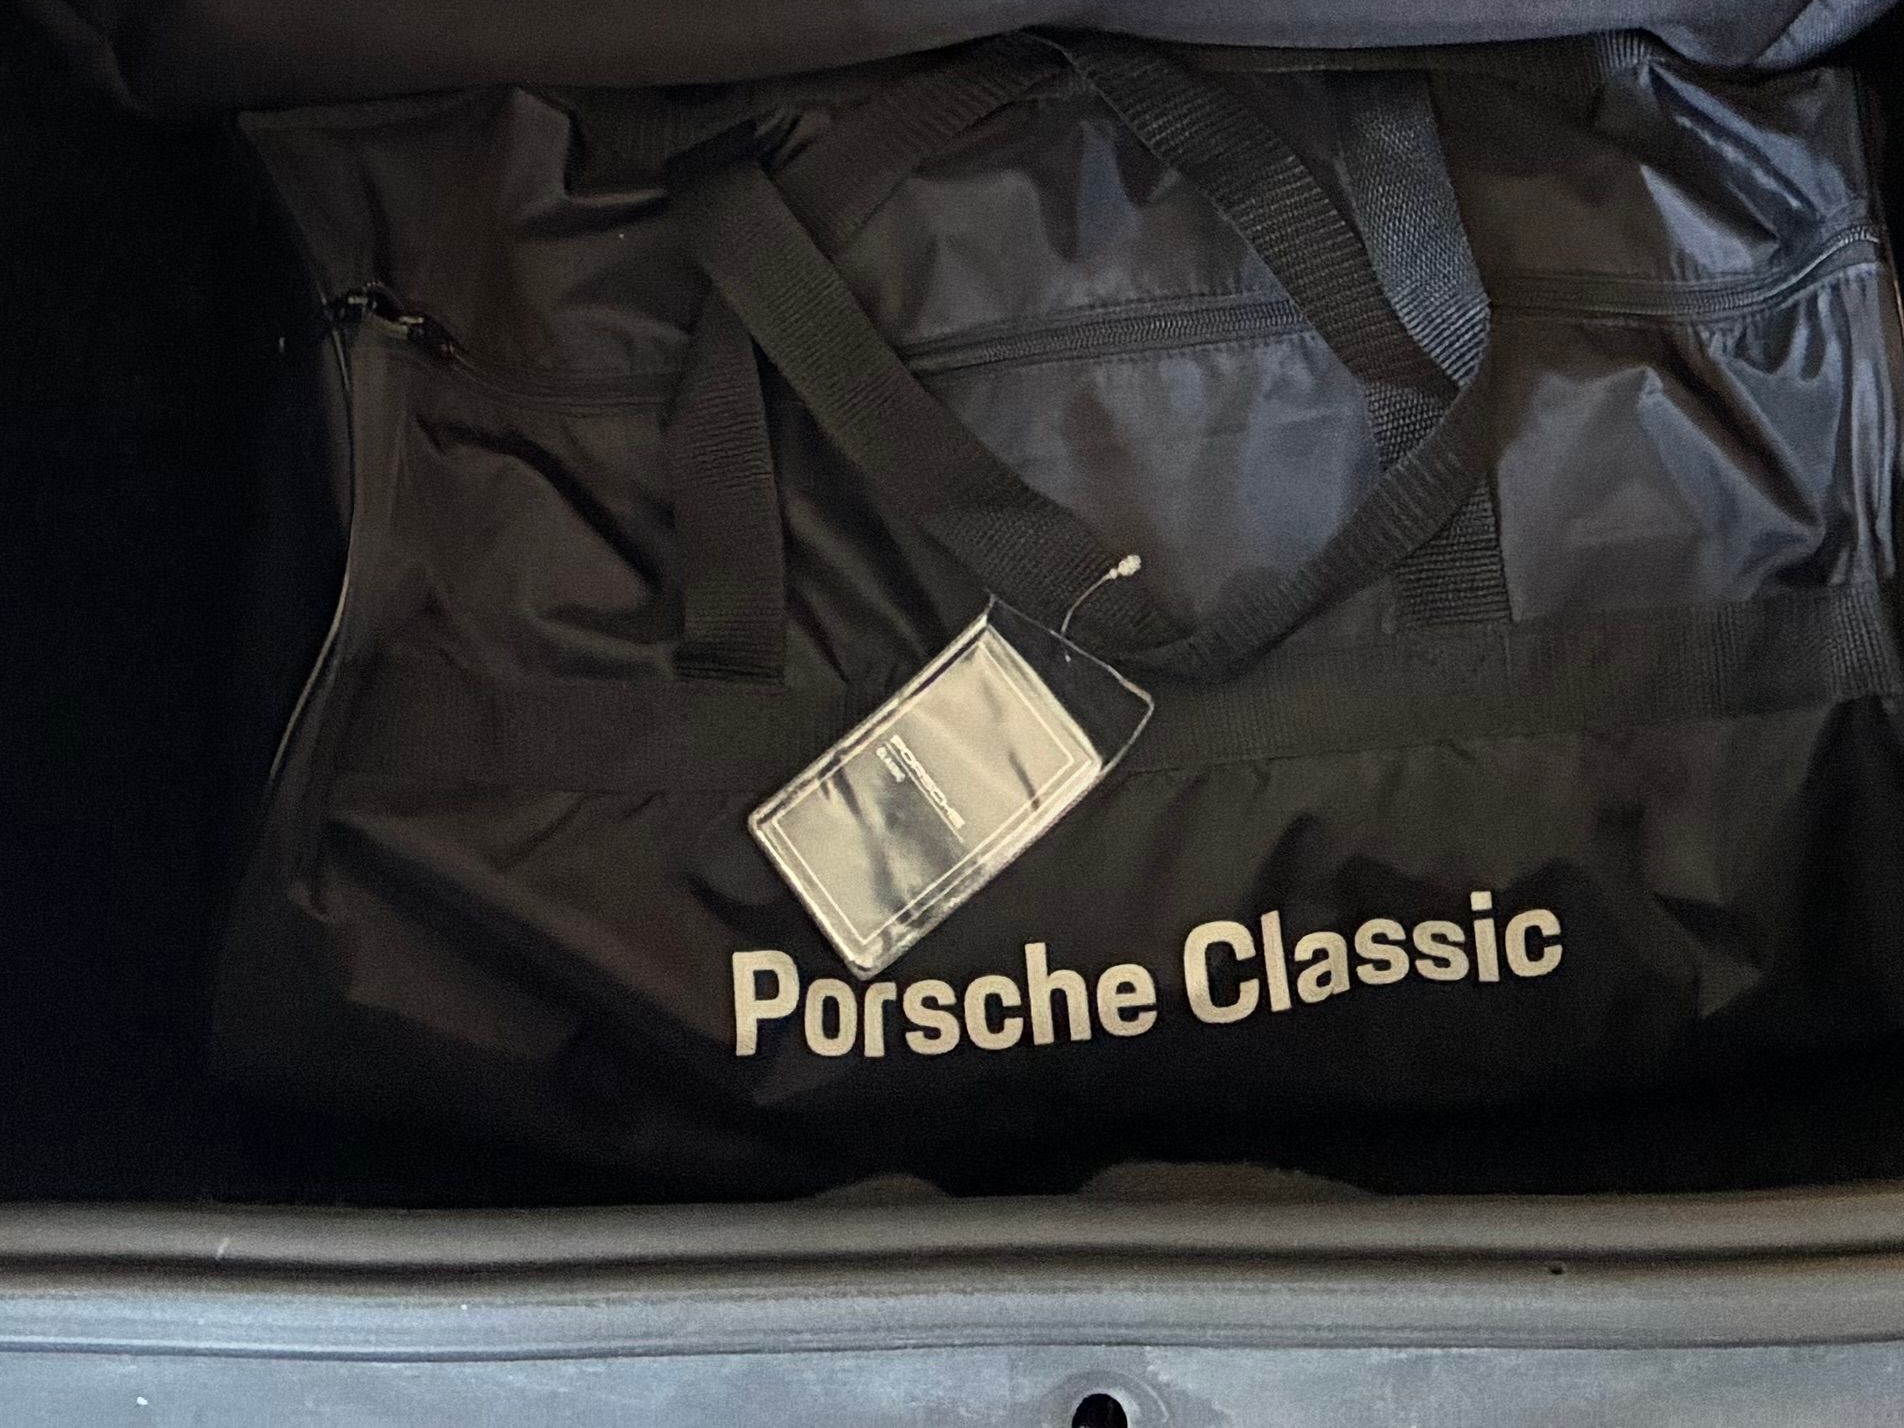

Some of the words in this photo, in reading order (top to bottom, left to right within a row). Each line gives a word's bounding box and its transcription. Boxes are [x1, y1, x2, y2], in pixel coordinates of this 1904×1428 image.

[890, 734, 966, 830] PORSCHE
[732, 941, 1157, 1058] Porsche
[1183, 891, 1563, 1024] Classic
